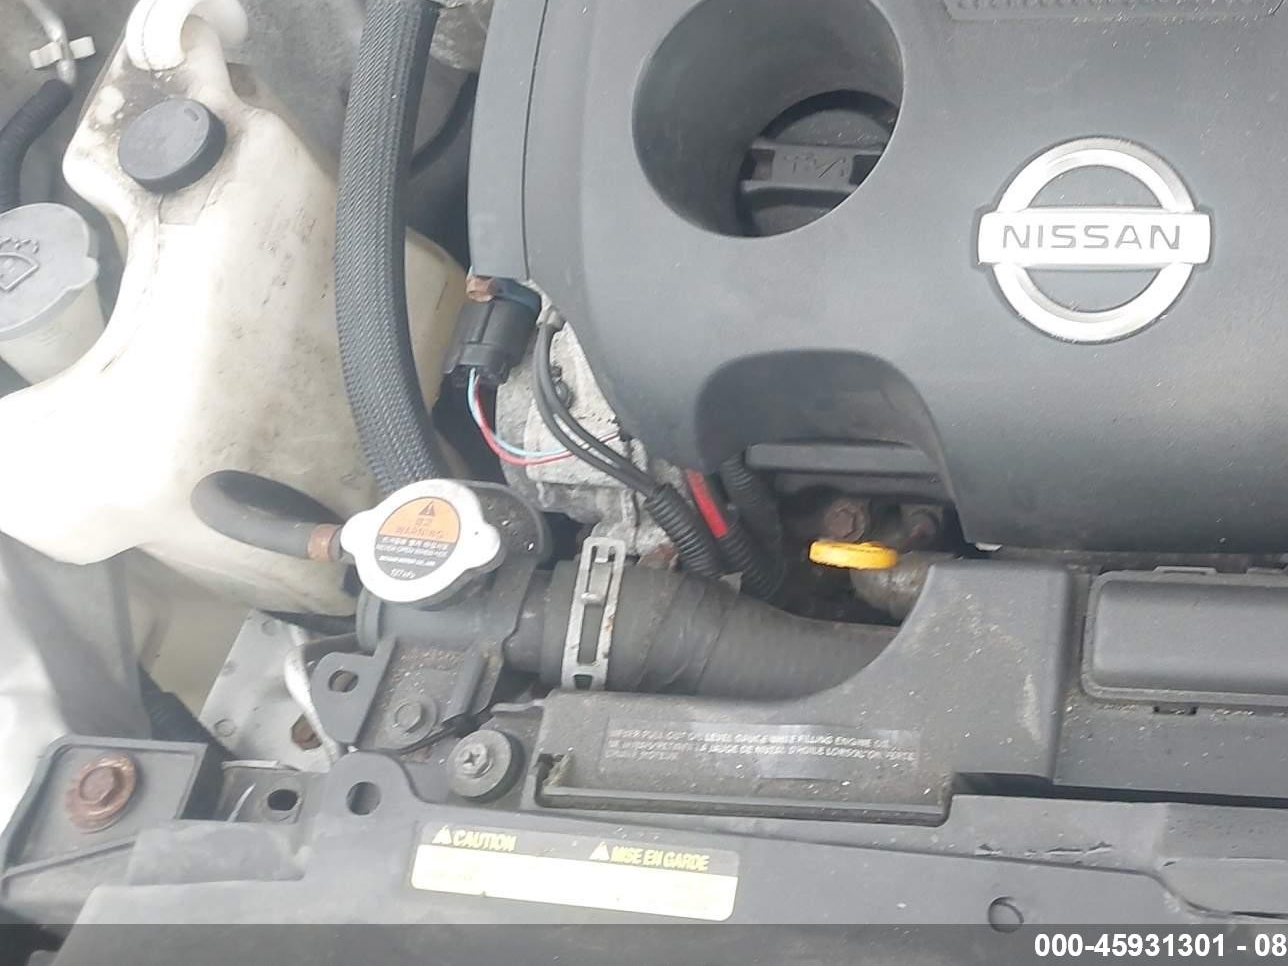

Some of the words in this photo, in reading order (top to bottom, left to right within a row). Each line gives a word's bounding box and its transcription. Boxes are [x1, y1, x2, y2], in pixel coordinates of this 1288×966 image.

[1002, 224, 1180, 250] NISSAN
[453, 830, 516, 851] CAUTION
[645, 849, 662, 866] EN
[663, 851, 709, 871] GARDE
